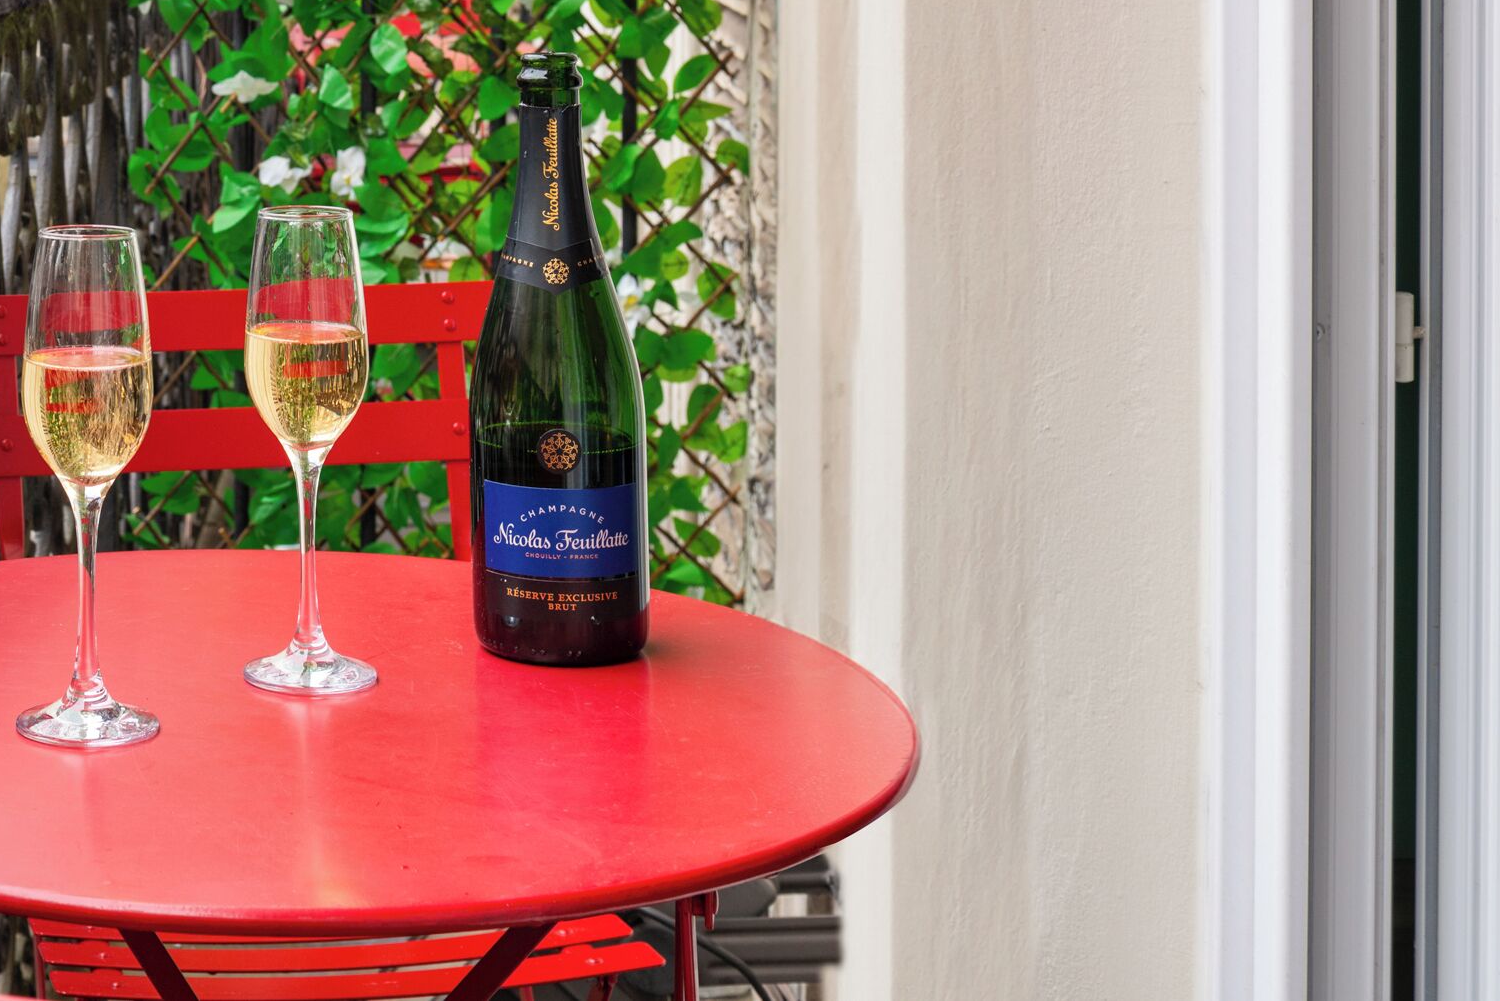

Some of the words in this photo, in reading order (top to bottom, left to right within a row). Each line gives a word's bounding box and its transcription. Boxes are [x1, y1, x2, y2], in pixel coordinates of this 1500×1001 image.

[542, 117, 560, 179] Feuillatte
[542, 182, 560, 231] Nicolas
[520, 504, 604, 524] CHAMPAGNE
[493, 521, 551, 550] Nicolas
[555, 528, 629, 551] Feuillatte
[525, 551, 561, 560] CHOUILLY
[506, 587, 554, 601] RÉSERVE
[558, 591, 618, 602] EXCLUSIVE
[548, 602, 577, 611] BRUT
